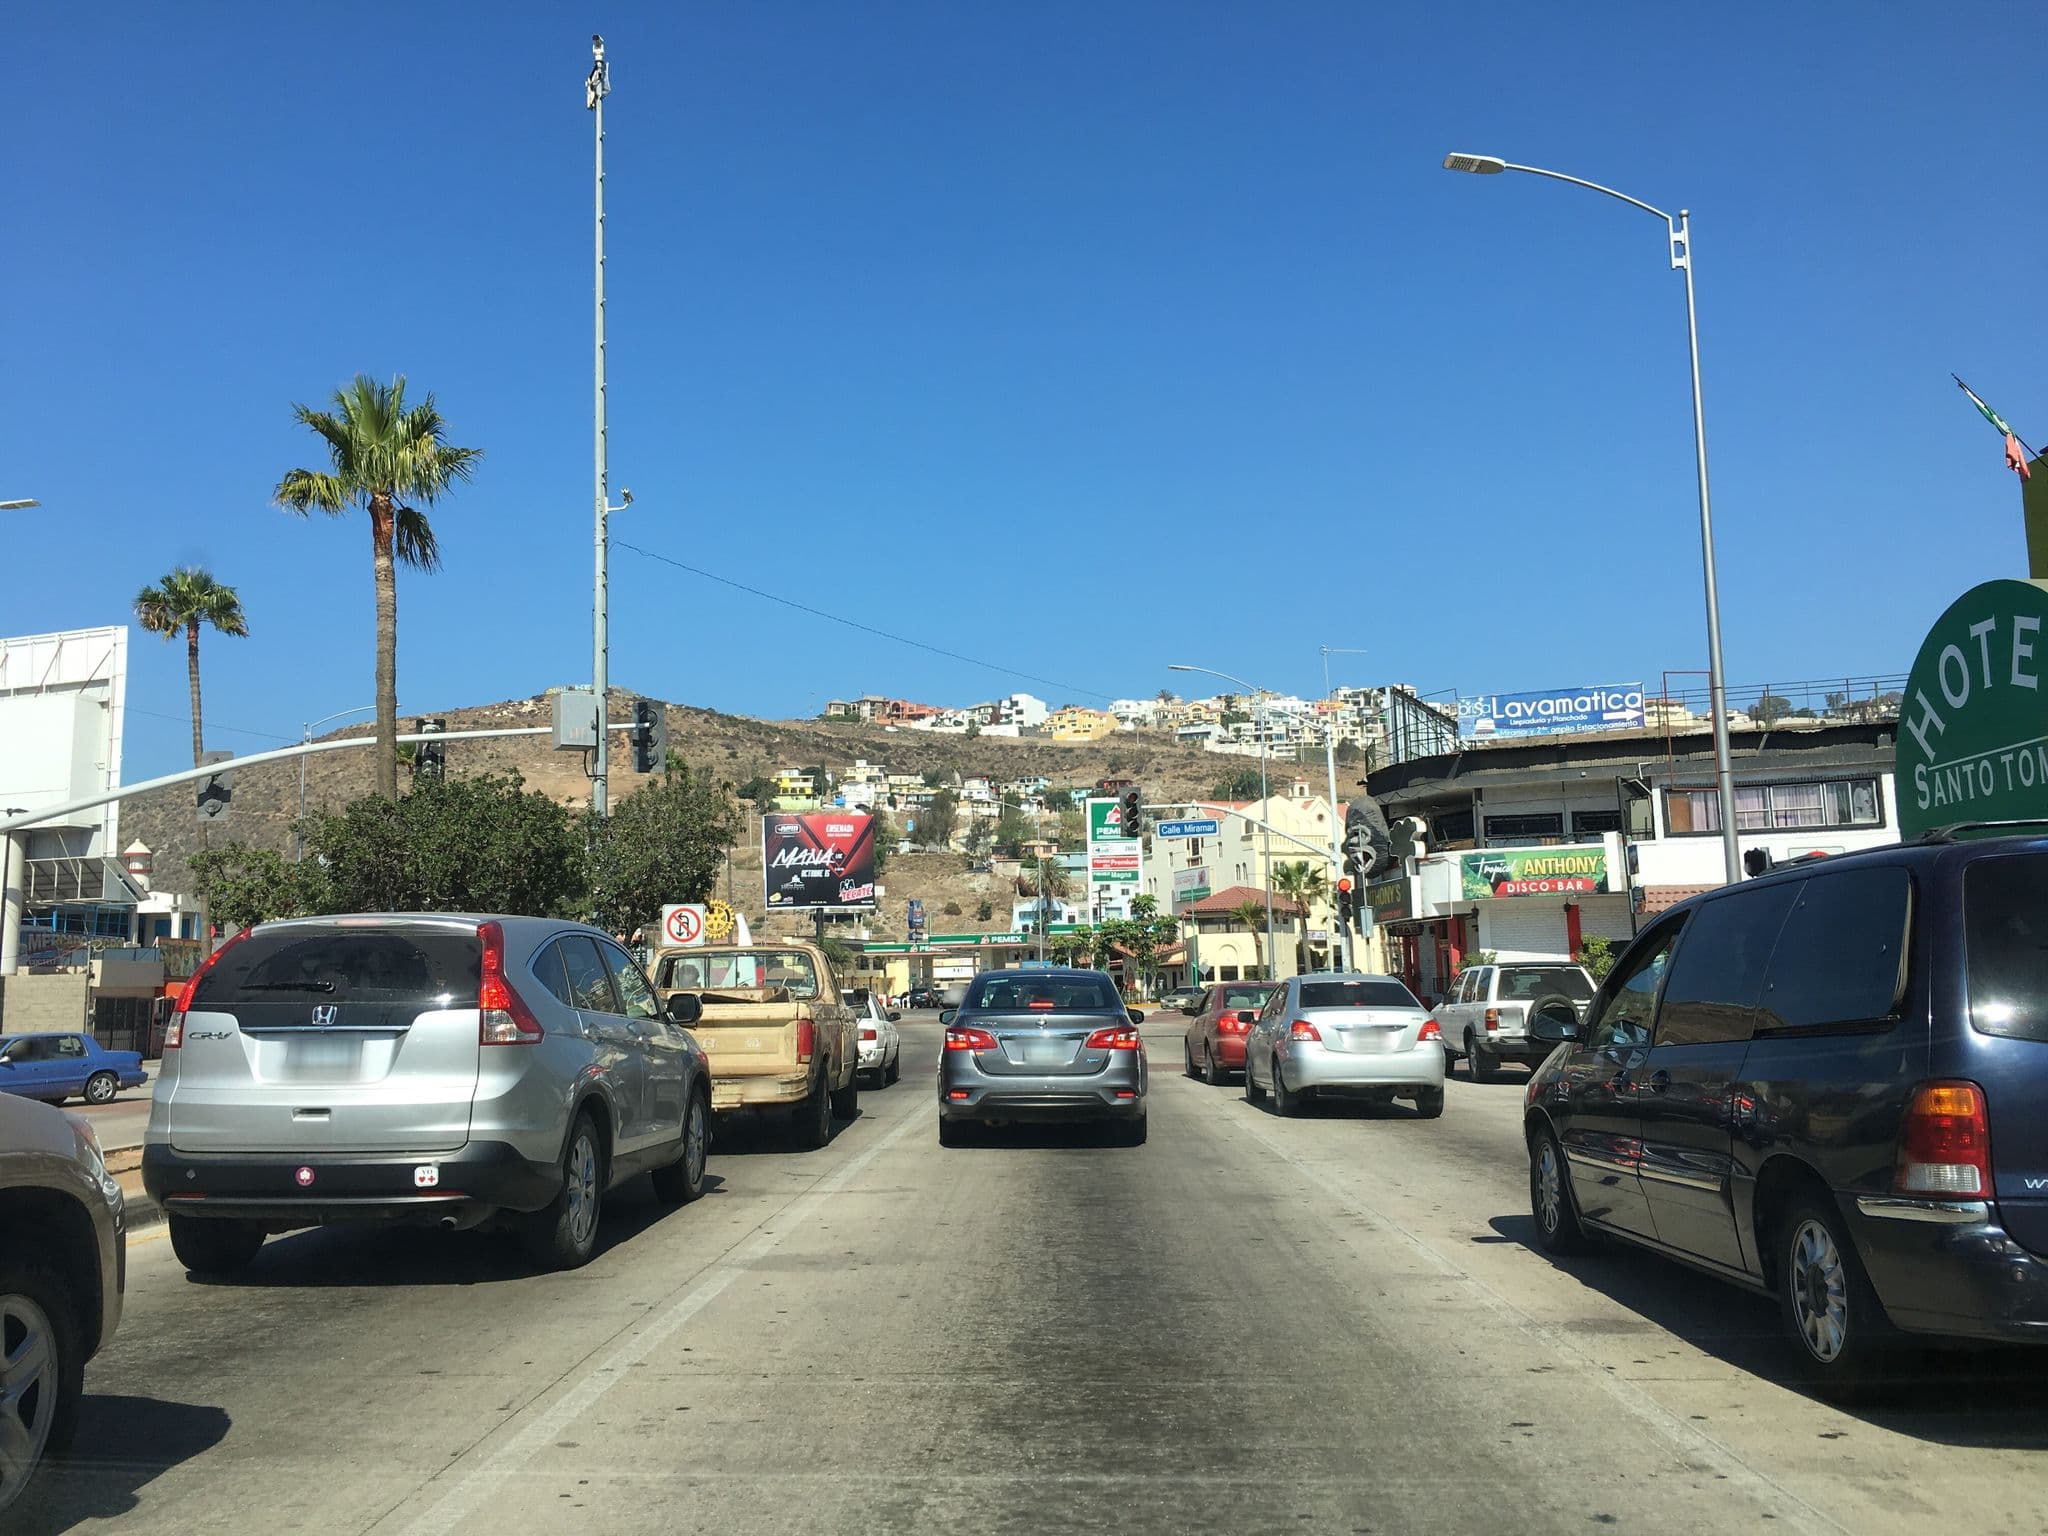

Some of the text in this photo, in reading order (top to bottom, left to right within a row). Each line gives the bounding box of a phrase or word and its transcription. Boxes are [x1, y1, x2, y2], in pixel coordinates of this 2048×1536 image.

[1492, 691, 1641, 718] Lavamatica
[1553, 714, 1588, 722] Planchado
[1551, 725, 1575, 734] amplio
[1577, 720, 1638, 732] Estacionamiento
[1915, 759, 1994, 810] SANTO
[1096, 827, 1120, 835] PEM
[1162, 824, 1215, 834] Calle Miramar
[771, 843, 836, 869] MANÁ
[1469, 857, 1516, 883] Tropical
[842, 887, 872, 900] TECATE
[1507, 881, 1583, 893] DISCO BAR
[189, 1032, 232, 1040] CR-V
